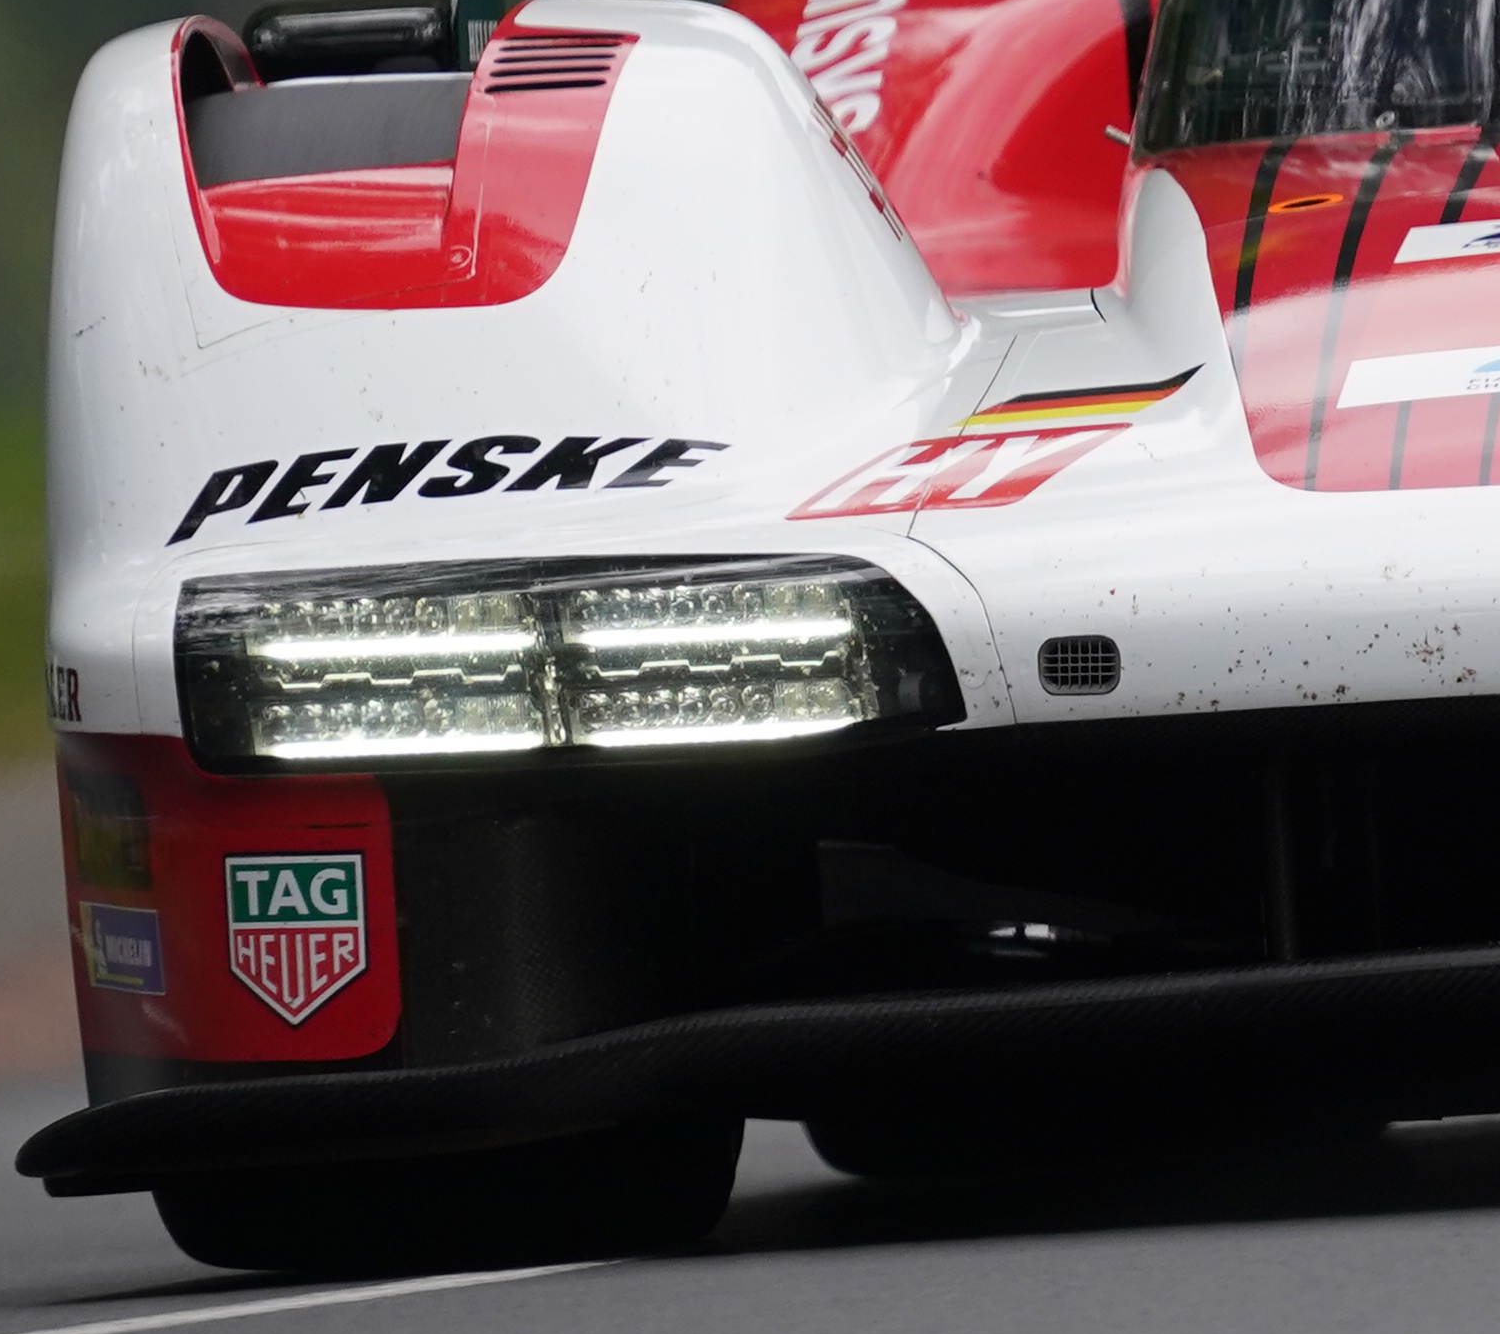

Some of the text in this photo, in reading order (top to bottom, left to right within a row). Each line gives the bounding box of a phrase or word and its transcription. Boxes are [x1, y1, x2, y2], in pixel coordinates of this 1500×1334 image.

[164, 434, 731, 547] PENSKE
[807, 430, 1117, 511] HY
[235, 867, 349, 916] TAG
[236, 932, 355, 1010] HEUER
